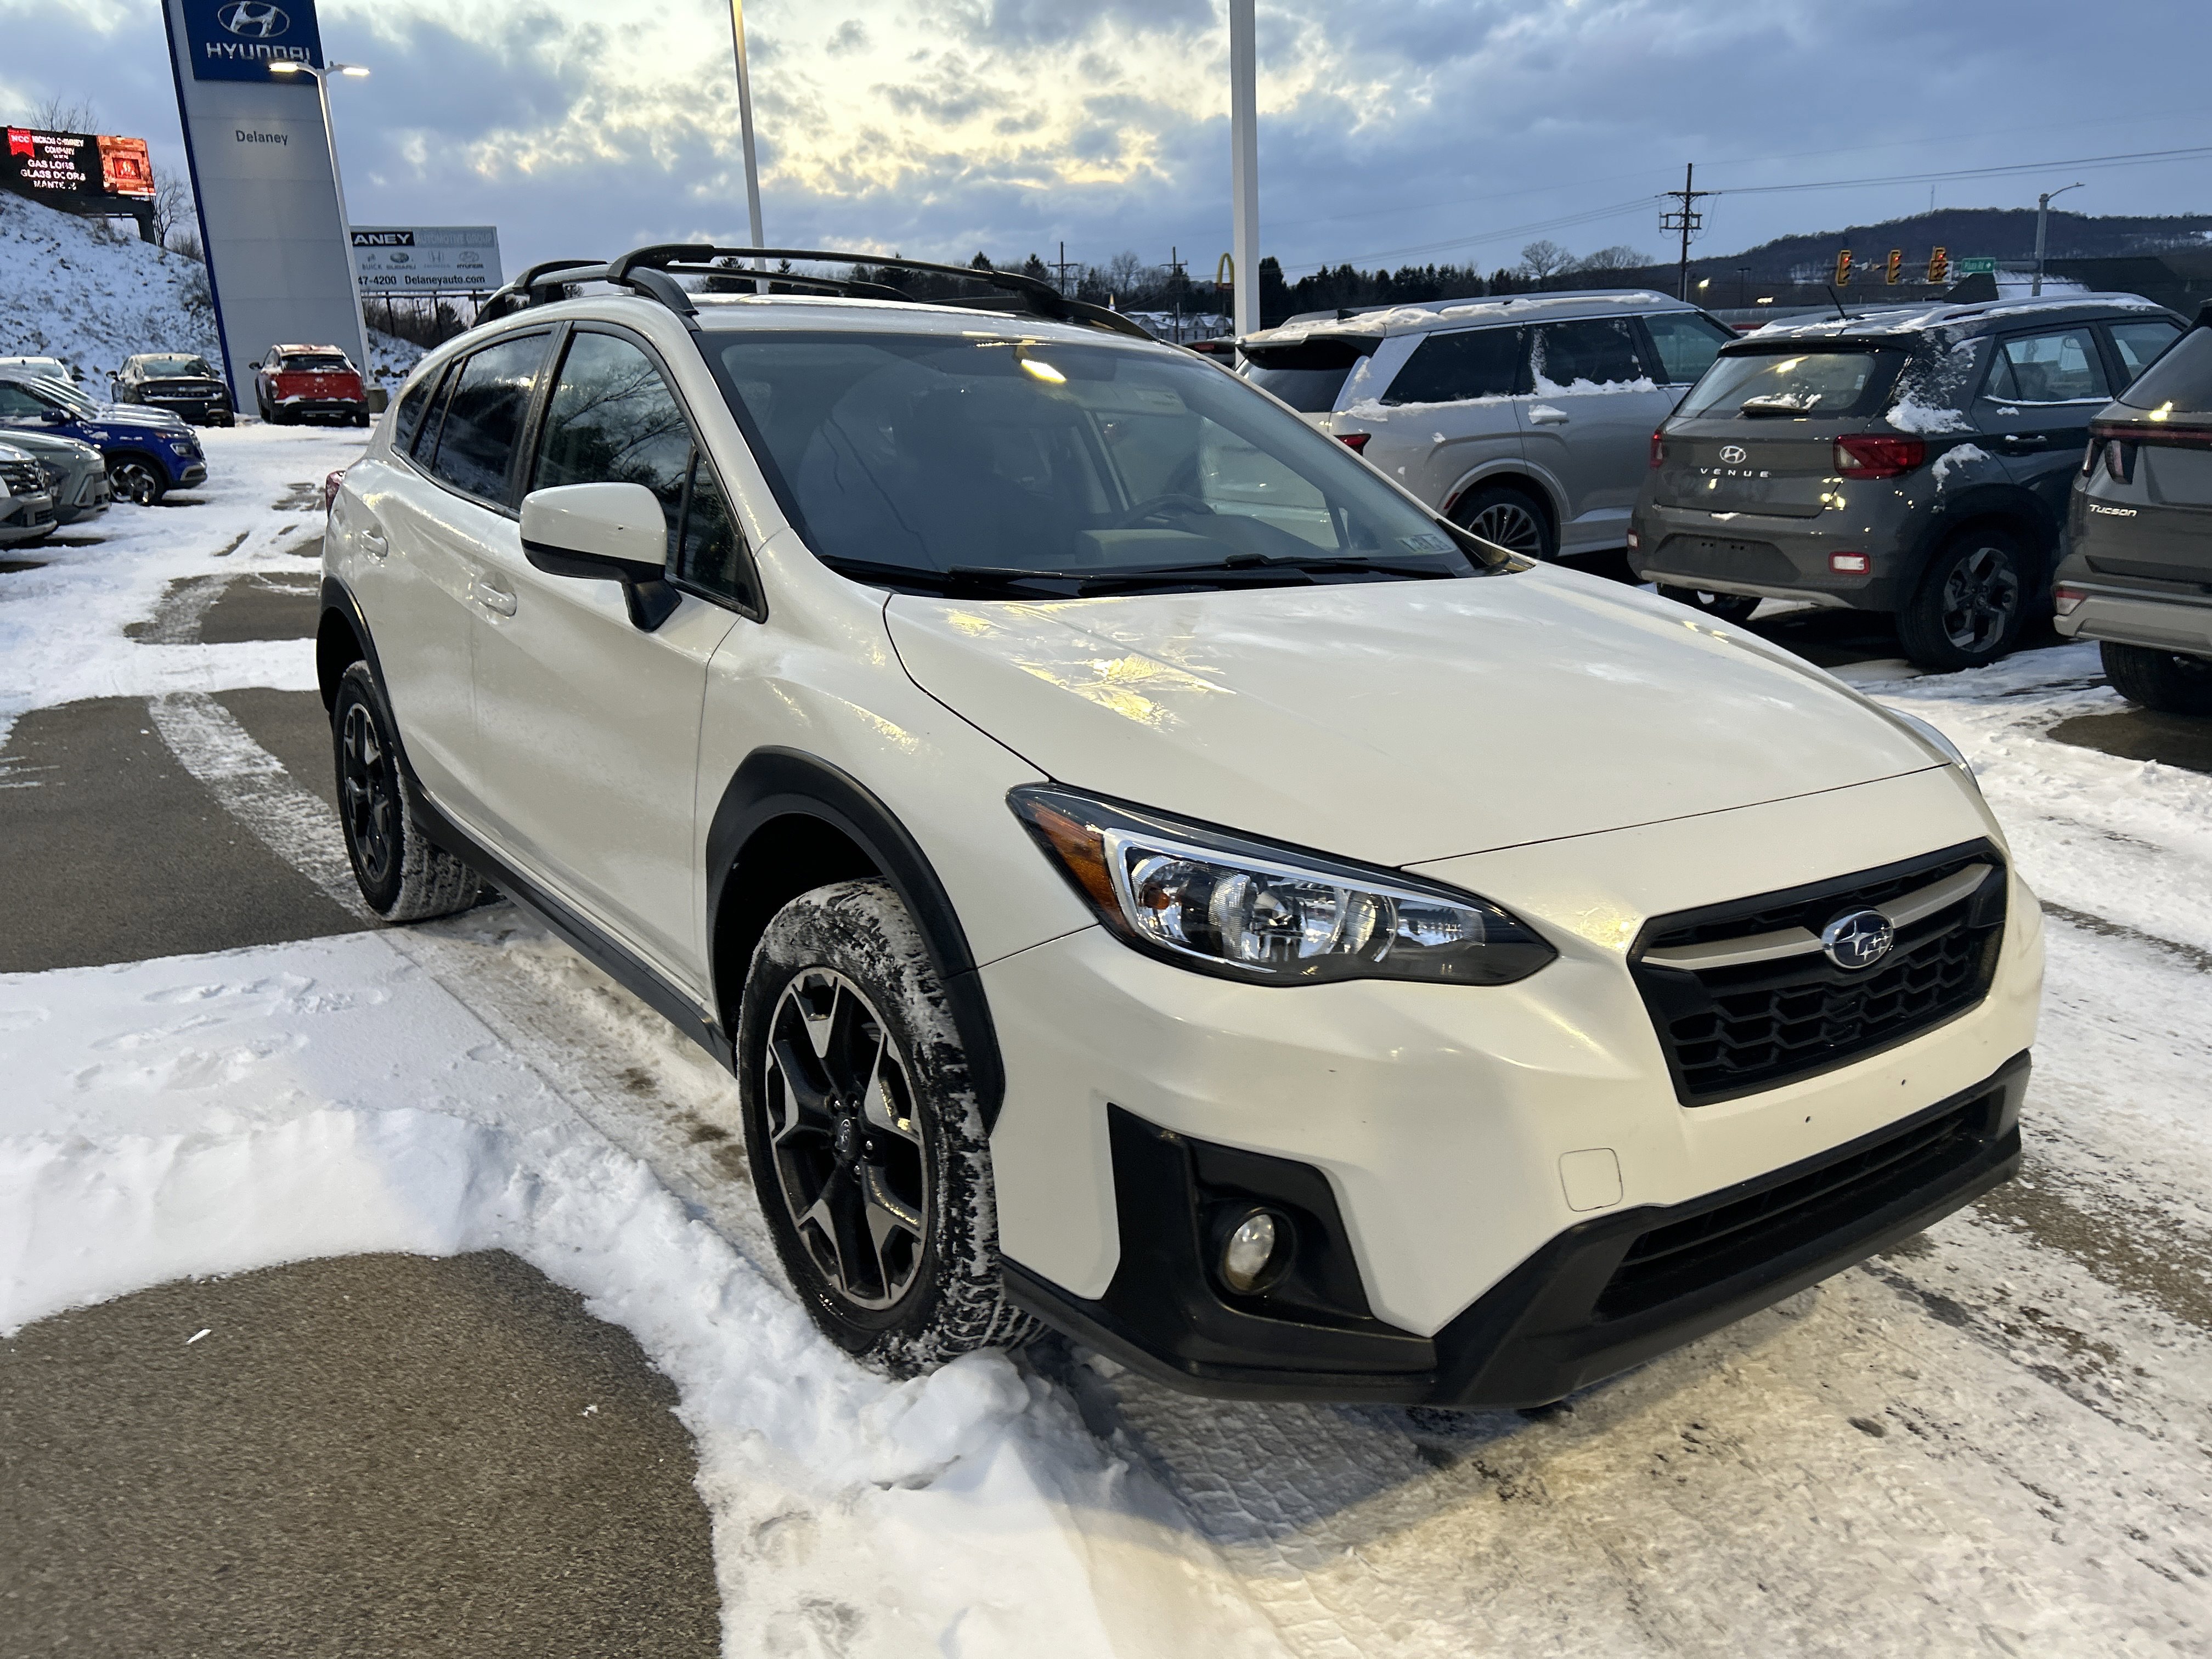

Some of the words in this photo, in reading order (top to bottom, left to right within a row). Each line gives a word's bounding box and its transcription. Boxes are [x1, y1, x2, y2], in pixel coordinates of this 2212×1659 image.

[206, 42, 311, 60] HYUNDAI
[235, 130, 288, 145] Delaney
[44, 145, 75, 155] COMPANY
[27, 159, 48, 168] GAS
[20, 169, 52, 179] GLASS
[33, 180, 77, 190] MANTES
[352, 234, 410, 245] ANEY
[358, 275, 397, 285] 47-4200
[405, 274, 486, 286] Delaneyauto.com
[1701, 468, 1770, 478] VENUE
